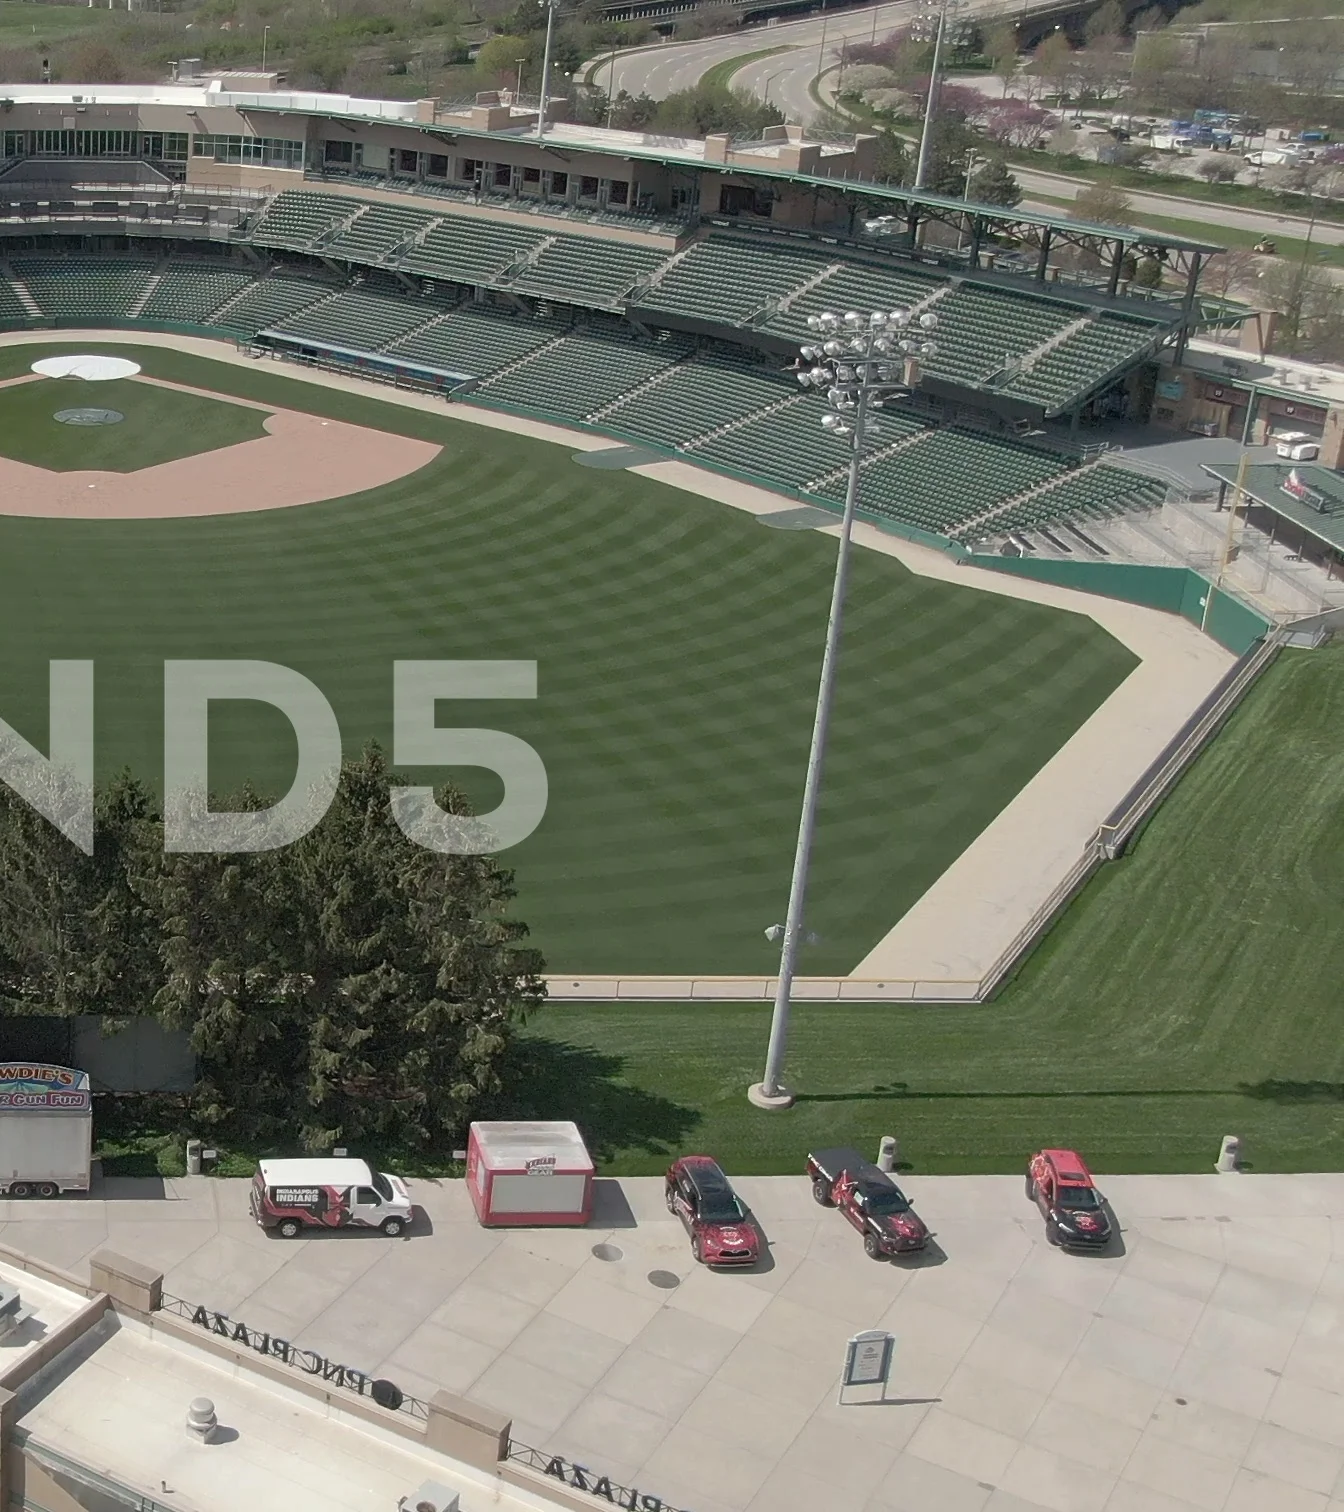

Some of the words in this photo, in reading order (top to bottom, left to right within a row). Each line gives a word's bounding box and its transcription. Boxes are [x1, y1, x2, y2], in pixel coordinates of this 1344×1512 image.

[12, 1093, 47, 1105] GUN
[51, 1093, 83, 1106] FUN
[276, 1194, 319, 1202] INDIANS
